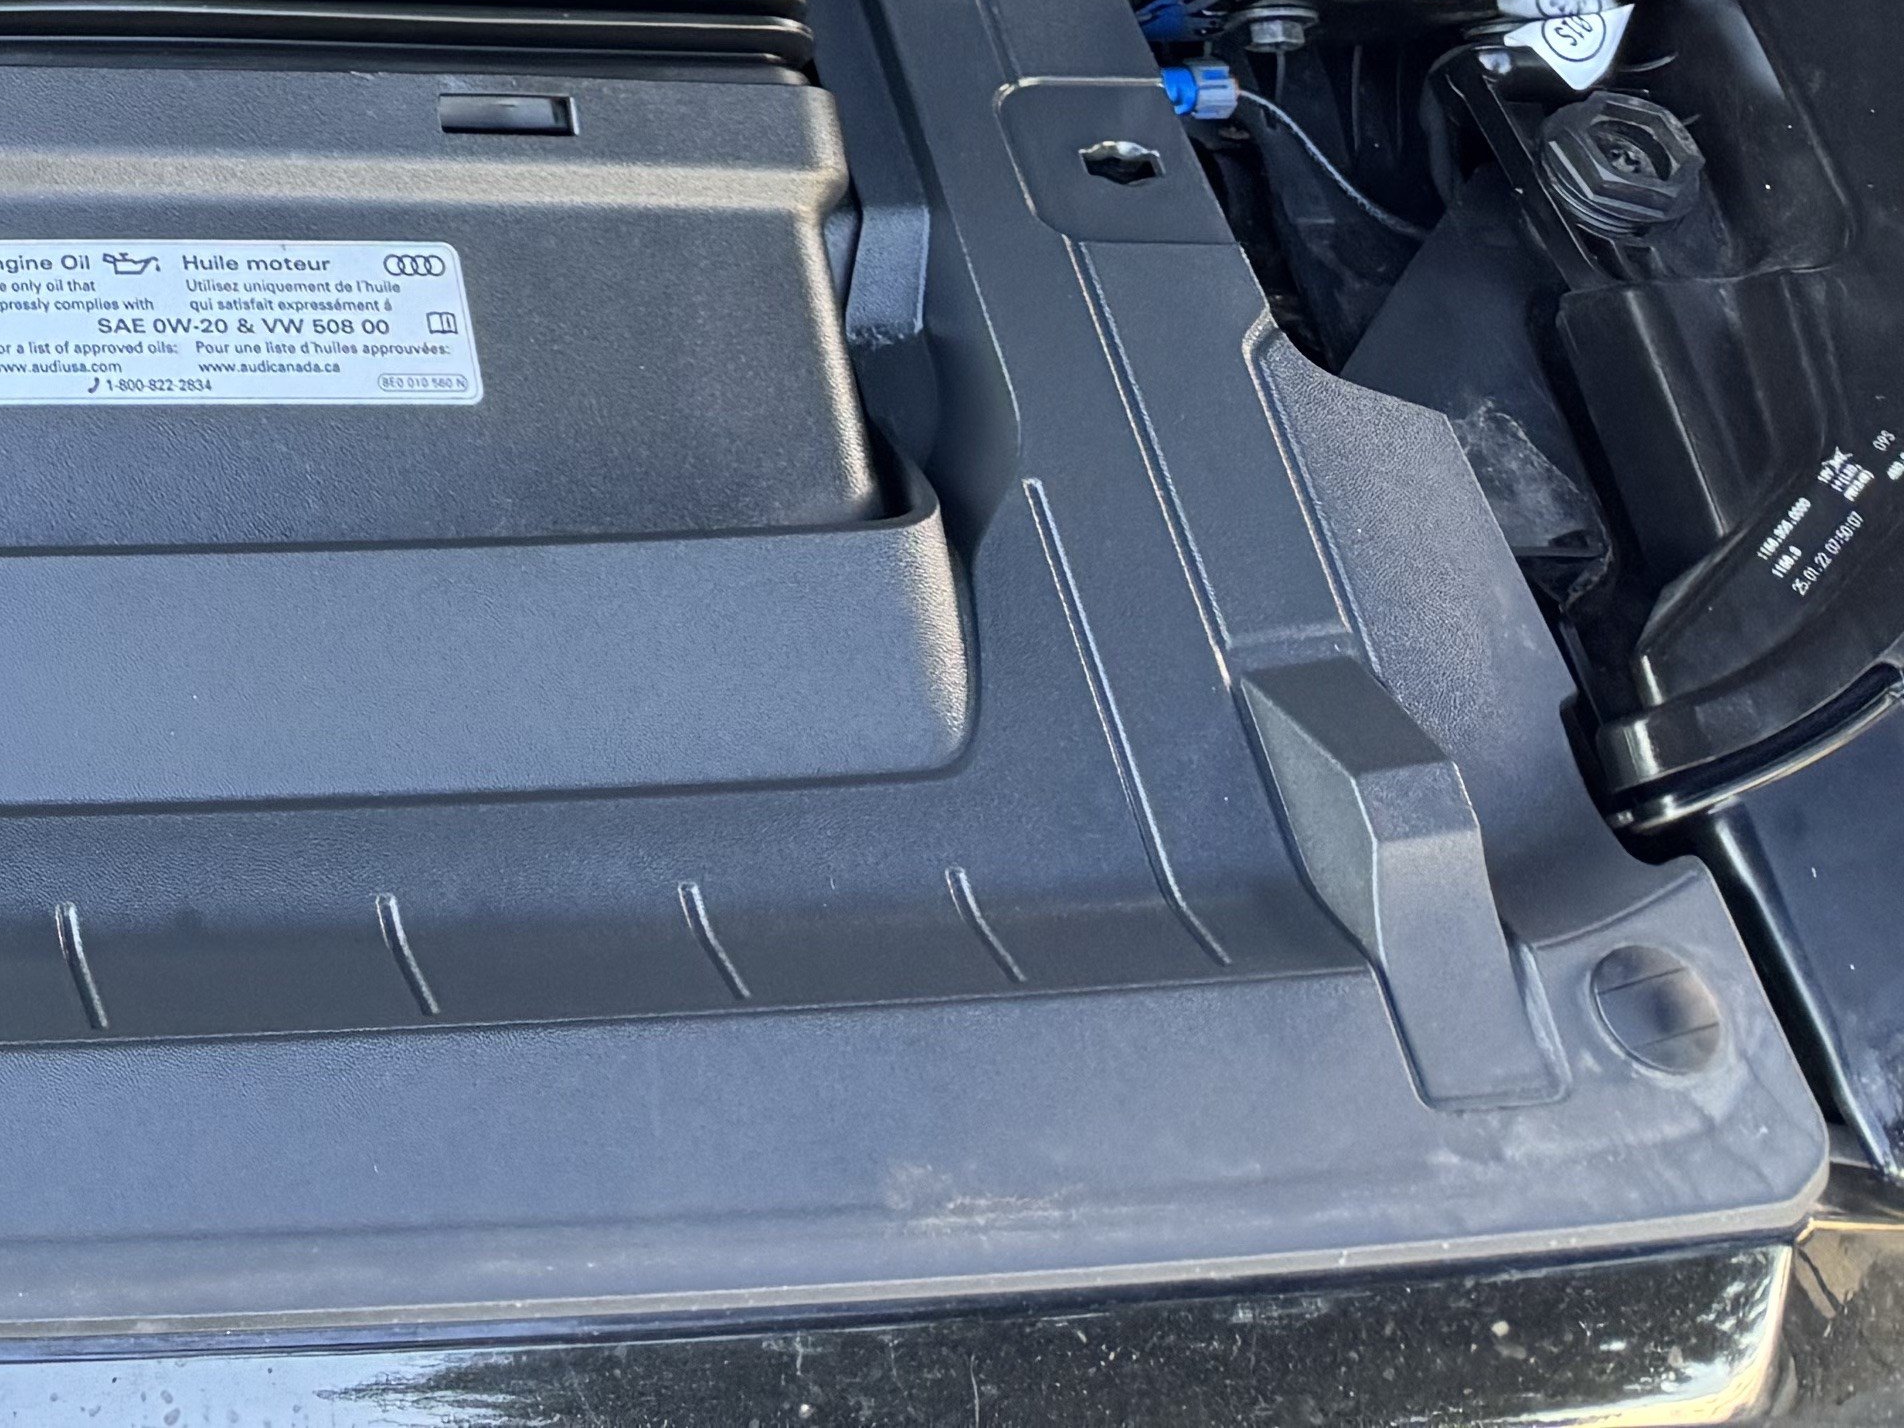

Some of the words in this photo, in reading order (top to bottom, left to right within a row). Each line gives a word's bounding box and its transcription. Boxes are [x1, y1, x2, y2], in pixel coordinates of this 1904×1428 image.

[60, 254, 91, 270] Oil
[182, 254, 239, 271] Huile
[246, 256, 331, 271] moteur
[11, 279, 42, 295] only
[46, 279, 63, 292] oil
[67, 279, 96, 292] that
[186, 279, 239, 293] Utilisez
[244, 279, 331, 295] uniquement
[335, 280, 353, 292] de
[54, 297, 120, 313] complies
[123, 297, 155, 311] with
[189, 298, 213, 313] qui
[217, 297, 274, 312] satisfait
[277, 297, 380, 314] expressément
[97, 317, 147, 334] SAE
[153, 317, 228, 334] 0W-20
[236, 317, 255, 334] &
[262, 317, 304, 334] VW
[313, 318, 354, 334] 508
[361, 318, 390, 334] 00
[16, 344, 25, 355] a
[28, 341, 51, 355] list
[55, 340, 70, 355] of
[74, 341, 143, 357] approved
[147, 341, 178, 355] oils:
[195, 341, 229, 354] Pour
[234, 343, 262, 354] une
[266, 340, 296, 354] liste
[362, 342, 450, 358] approuvées:
[198, 360, 341, 374] www.audicanada.ca
[106, 378, 212, 392] 1-800-822-2834
[407, 377, 429, 388] 010
